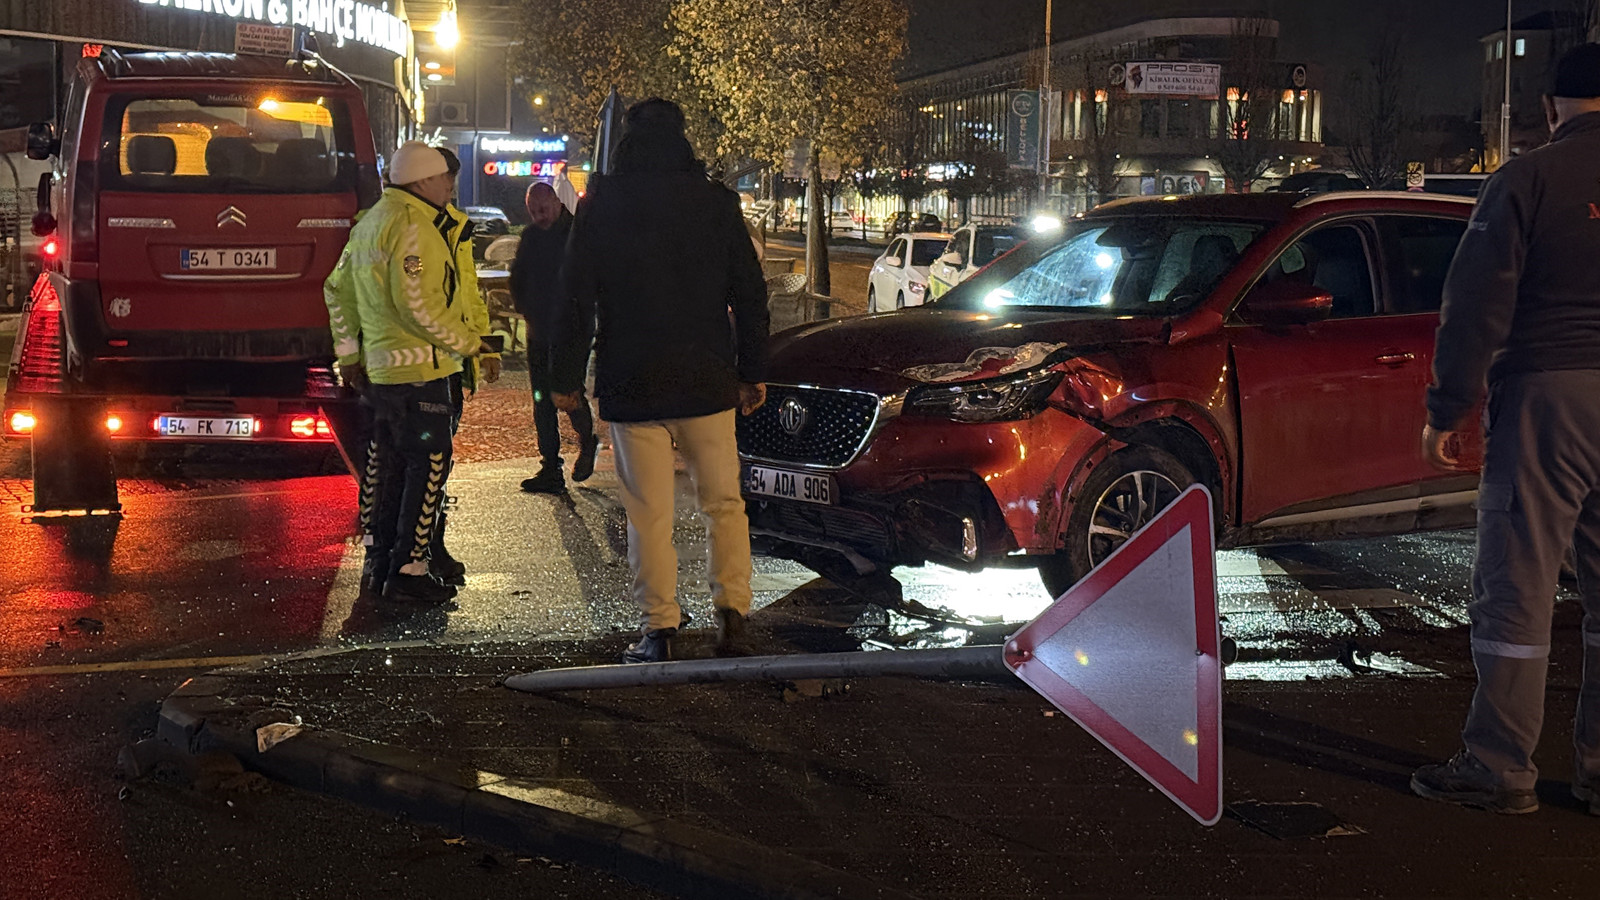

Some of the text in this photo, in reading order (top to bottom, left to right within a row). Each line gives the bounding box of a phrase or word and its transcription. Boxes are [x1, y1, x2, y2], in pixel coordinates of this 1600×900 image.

[190, 252, 209, 266] 54
[217, 252, 226, 266] T
[234, 251, 269, 267] 0341
[169, 419, 250, 435] 54 FK 713
[751, 469, 829, 502] 54 ADA 906
